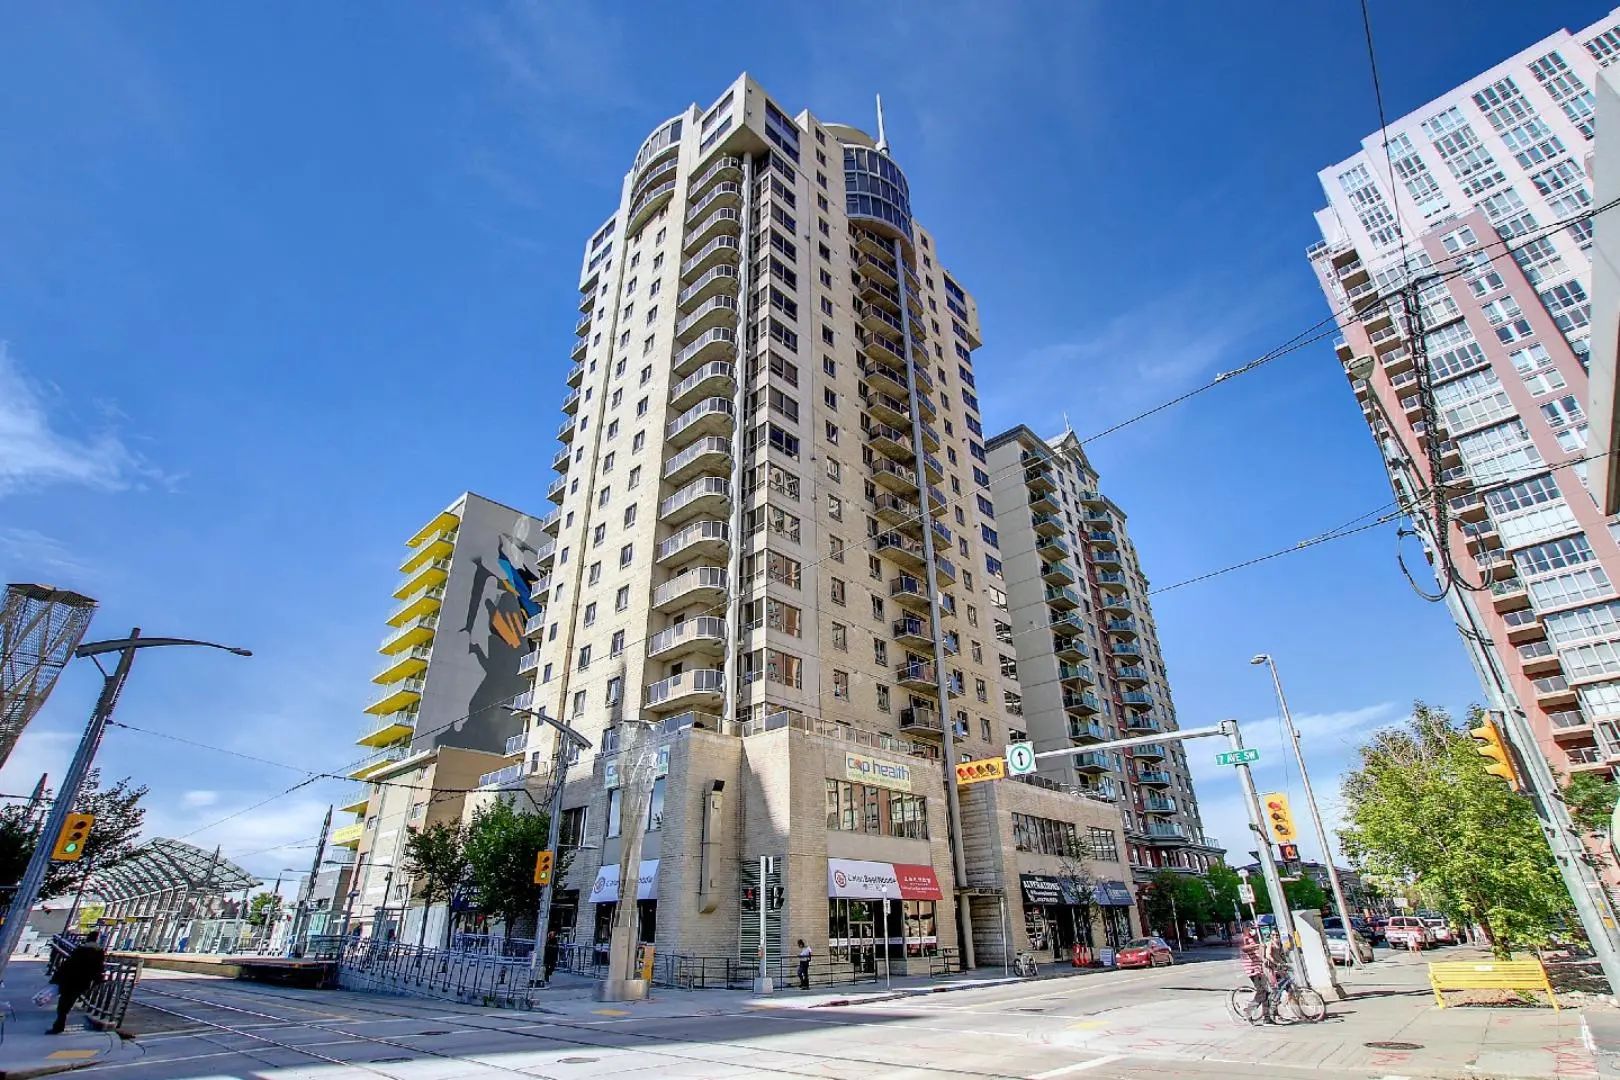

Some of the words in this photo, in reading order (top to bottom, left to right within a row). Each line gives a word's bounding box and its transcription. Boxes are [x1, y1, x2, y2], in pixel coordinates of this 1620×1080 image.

[1227, 752, 1241, 763] AVE
[1244, 750, 1256, 761] SW
[872, 760, 910, 781] health
